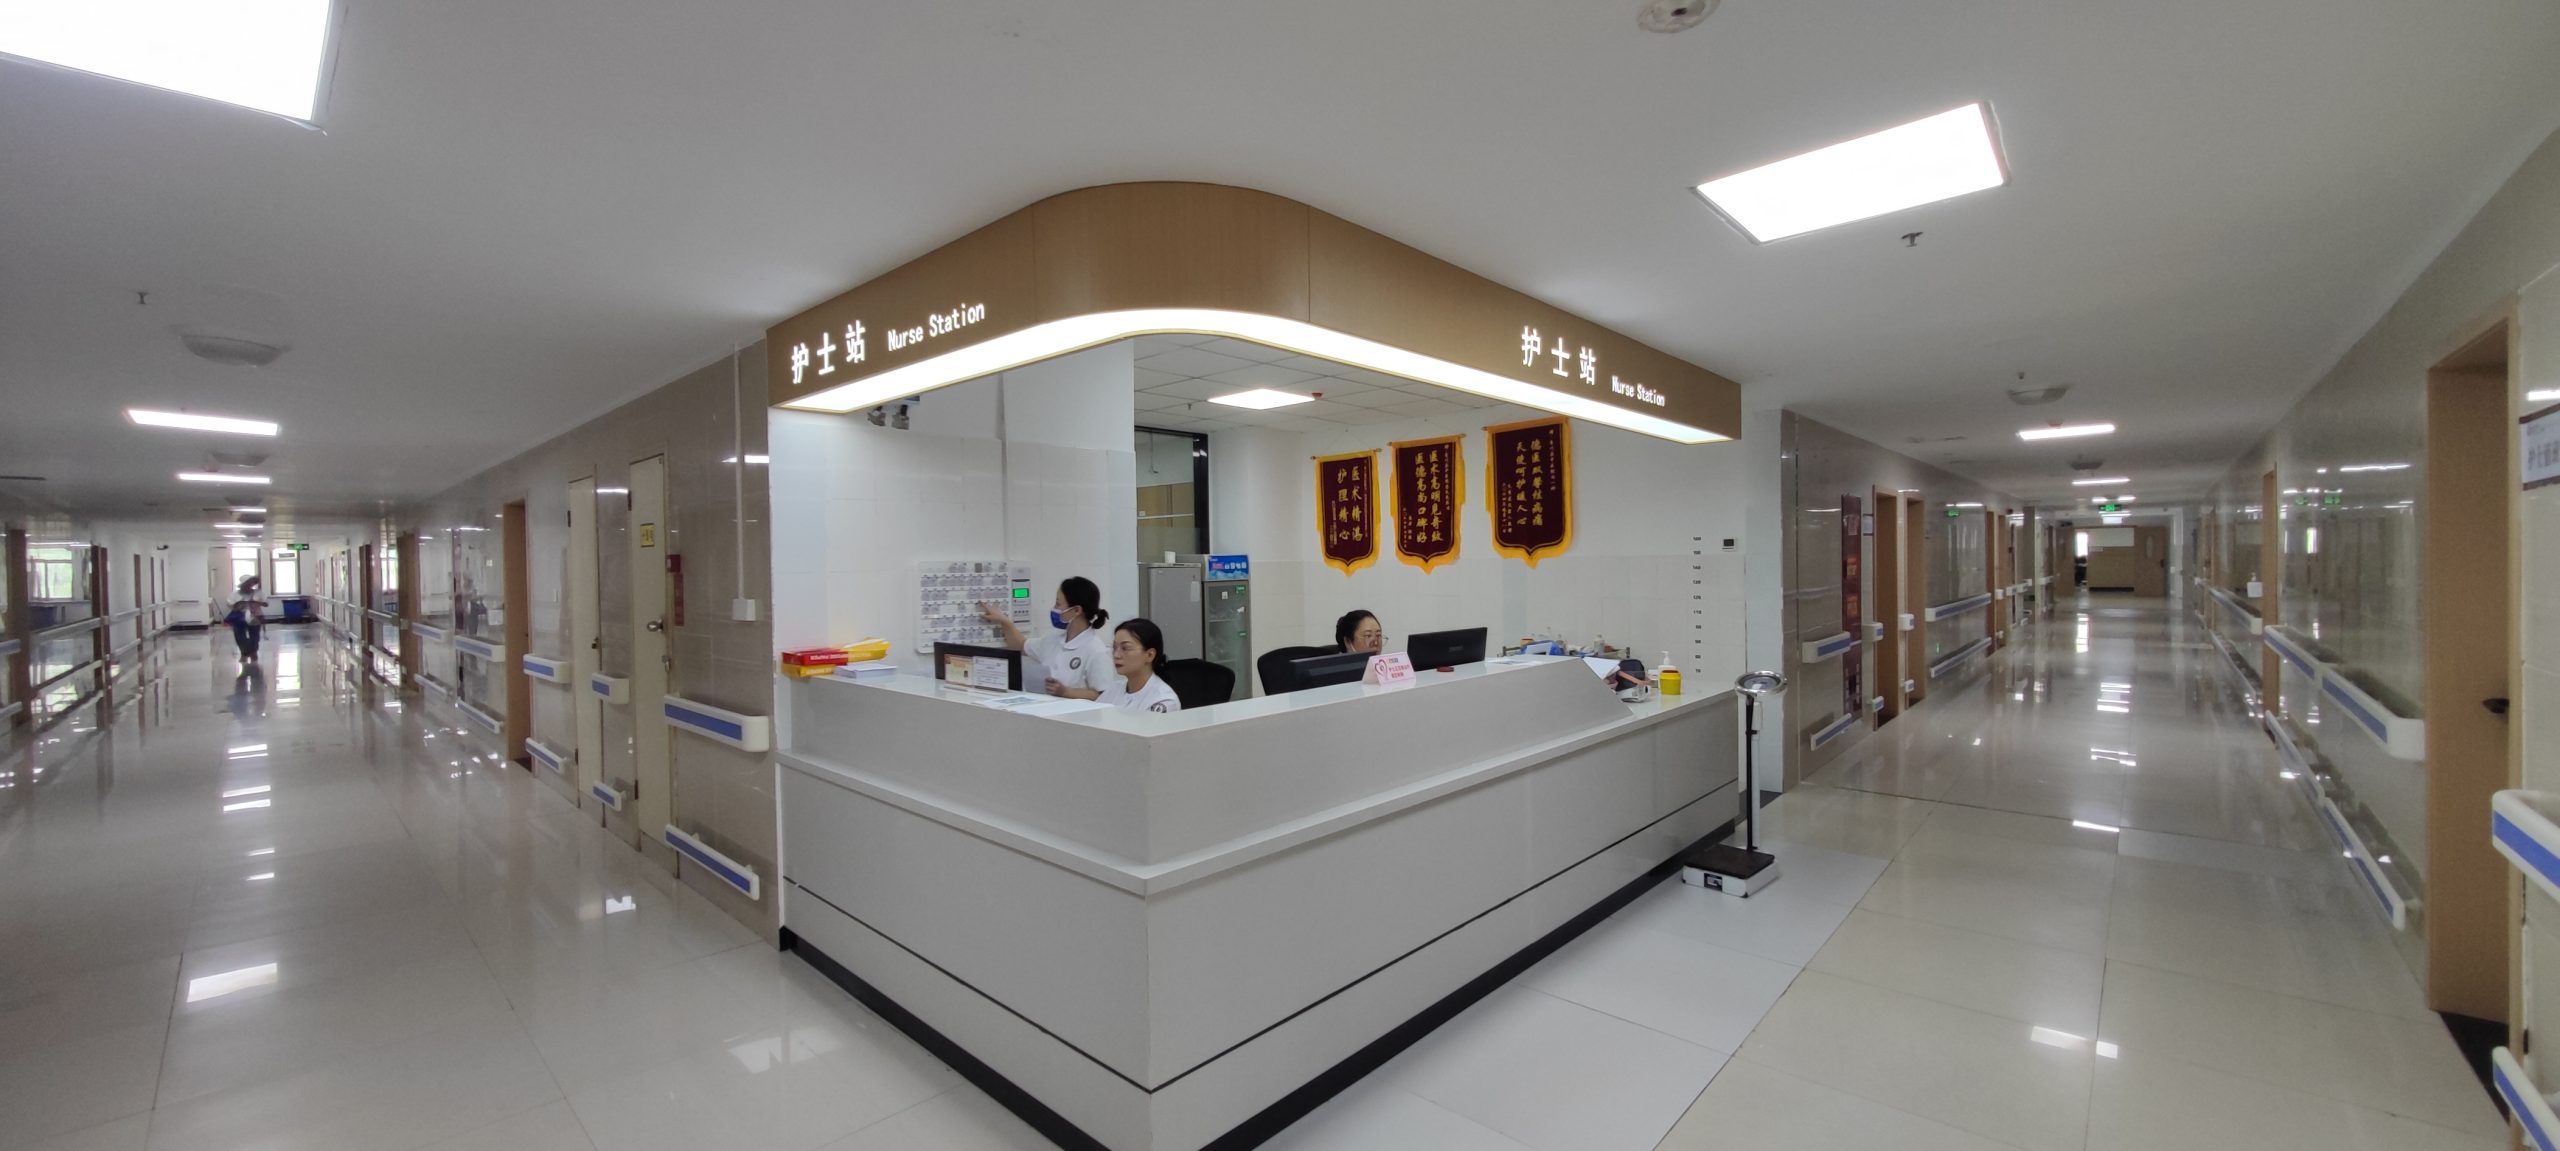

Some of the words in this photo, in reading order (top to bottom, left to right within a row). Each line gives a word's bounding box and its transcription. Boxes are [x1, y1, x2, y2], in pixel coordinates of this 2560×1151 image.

[791, 319, 866, 384] 护士站
[887, 325, 923, 352] Nurse
[929, 303, 985, 337] Station
[1521, 326, 1597, 386] 护士站
[1611, 375, 1635, 398] Nurse
[1636, 383, 1666, 407] Station
[1351, 465, 1363, 542] 医术精湛
